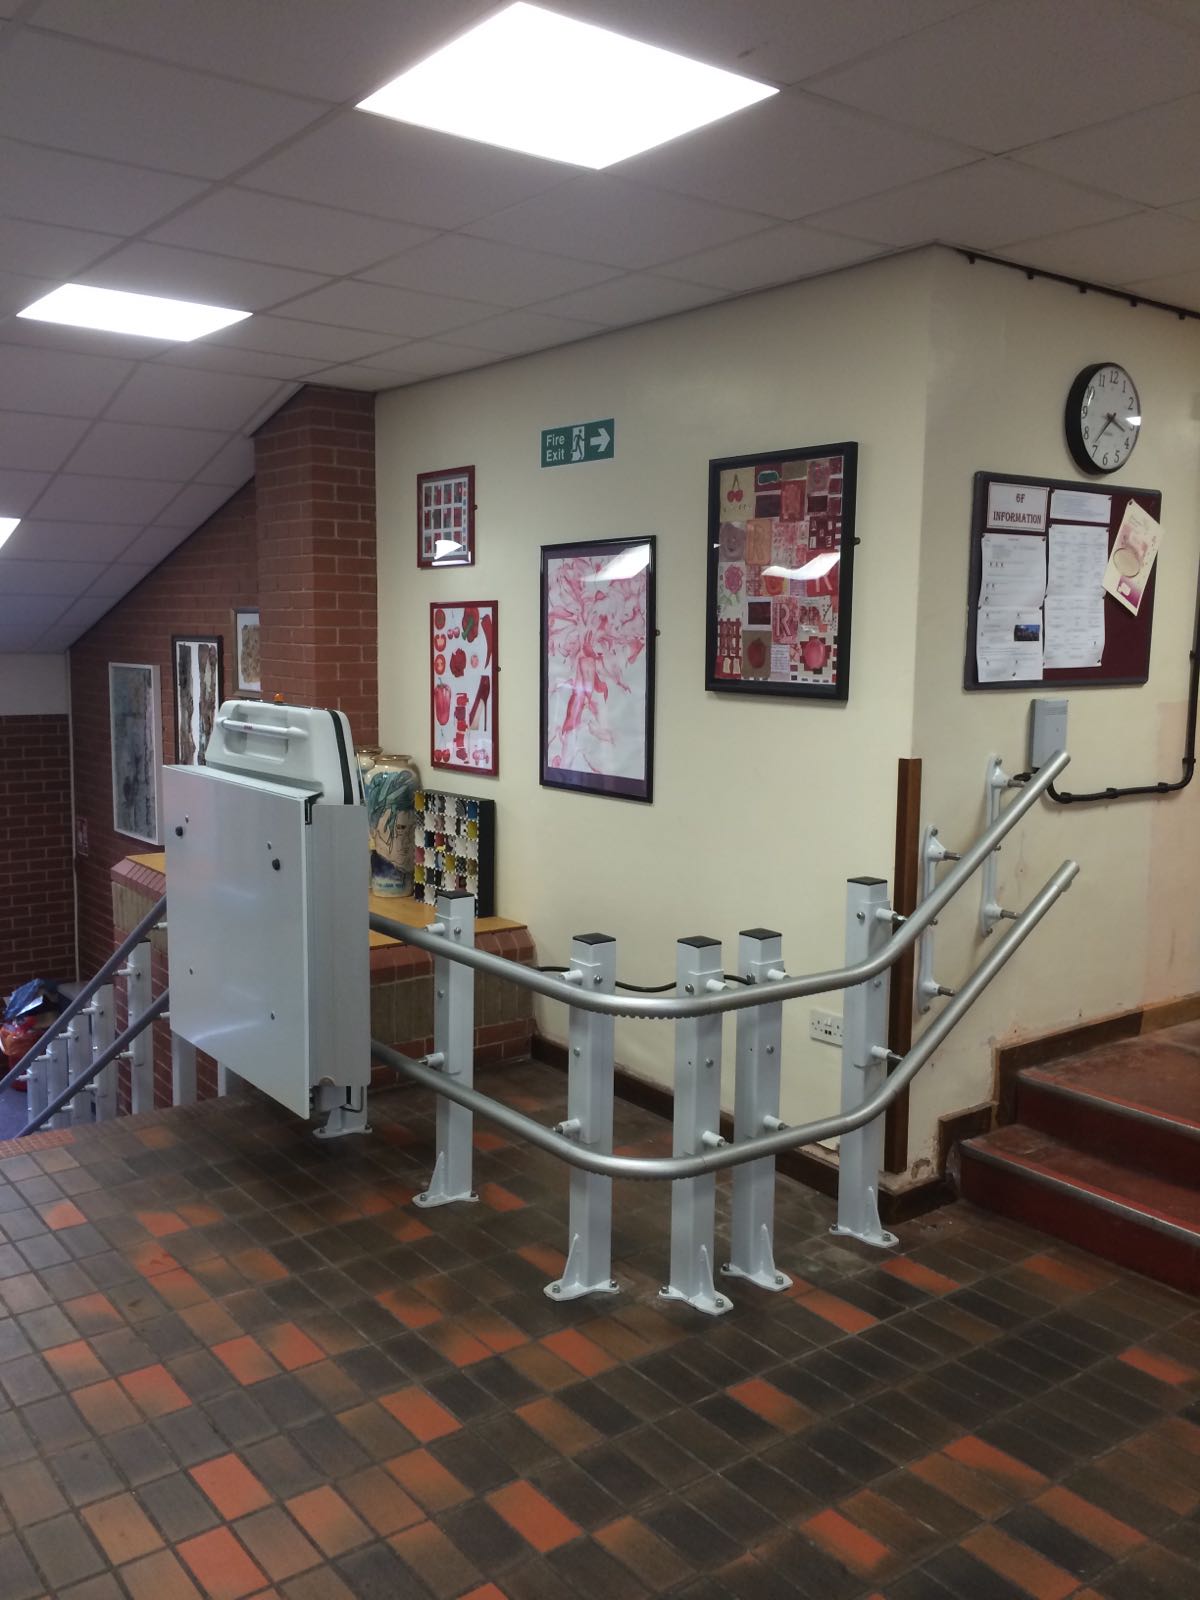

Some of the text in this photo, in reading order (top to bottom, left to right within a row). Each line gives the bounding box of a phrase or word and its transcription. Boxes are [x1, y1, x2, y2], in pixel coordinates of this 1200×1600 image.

[1099, 375, 1105, 387] 11
[1110, 371, 1119, 384] 12
[1128, 397, 1134, 410] 2
[1082, 406, 1087, 419] 9
[1084, 426, 1089, 440] 8
[547, 434, 564, 446] Fire
[1124, 438, 1129, 449] 4
[547, 449, 564, 461] Exit
[1092, 445, 1098, 457] 7
[1114, 450, 1119, 463] 5
[1103, 453, 1108, 465] 6
[993, 511, 1041, 524] INFORMATION
